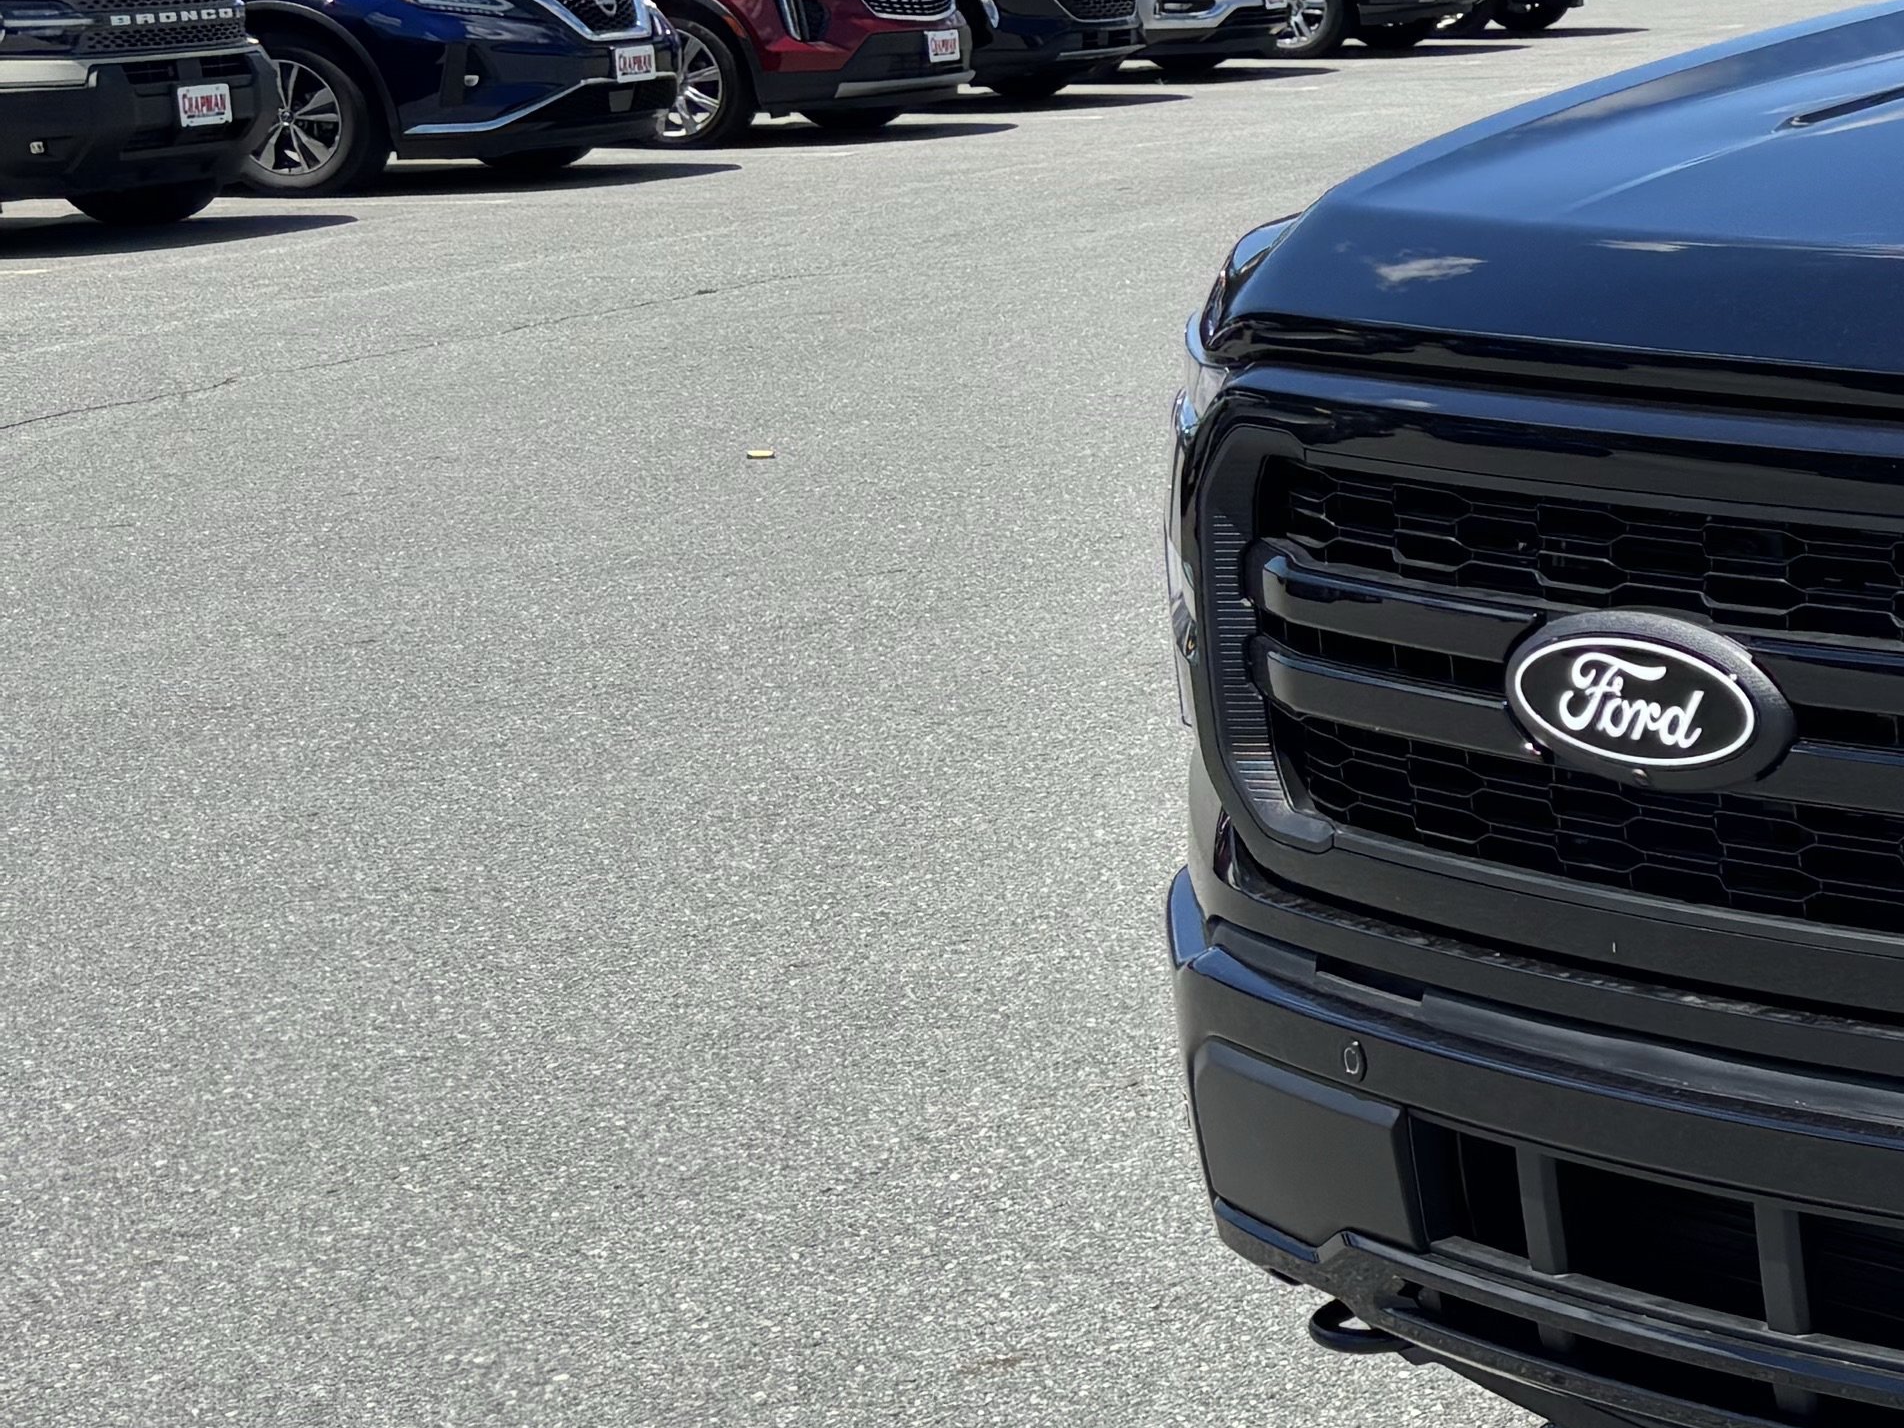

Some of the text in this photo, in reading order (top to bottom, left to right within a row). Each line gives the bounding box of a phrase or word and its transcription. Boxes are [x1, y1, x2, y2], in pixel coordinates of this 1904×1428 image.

[110, 7, 233, 26] BRONCO
[182, 92, 227, 115] CHAPMAN
[1558, 651, 1706, 749] Ford
